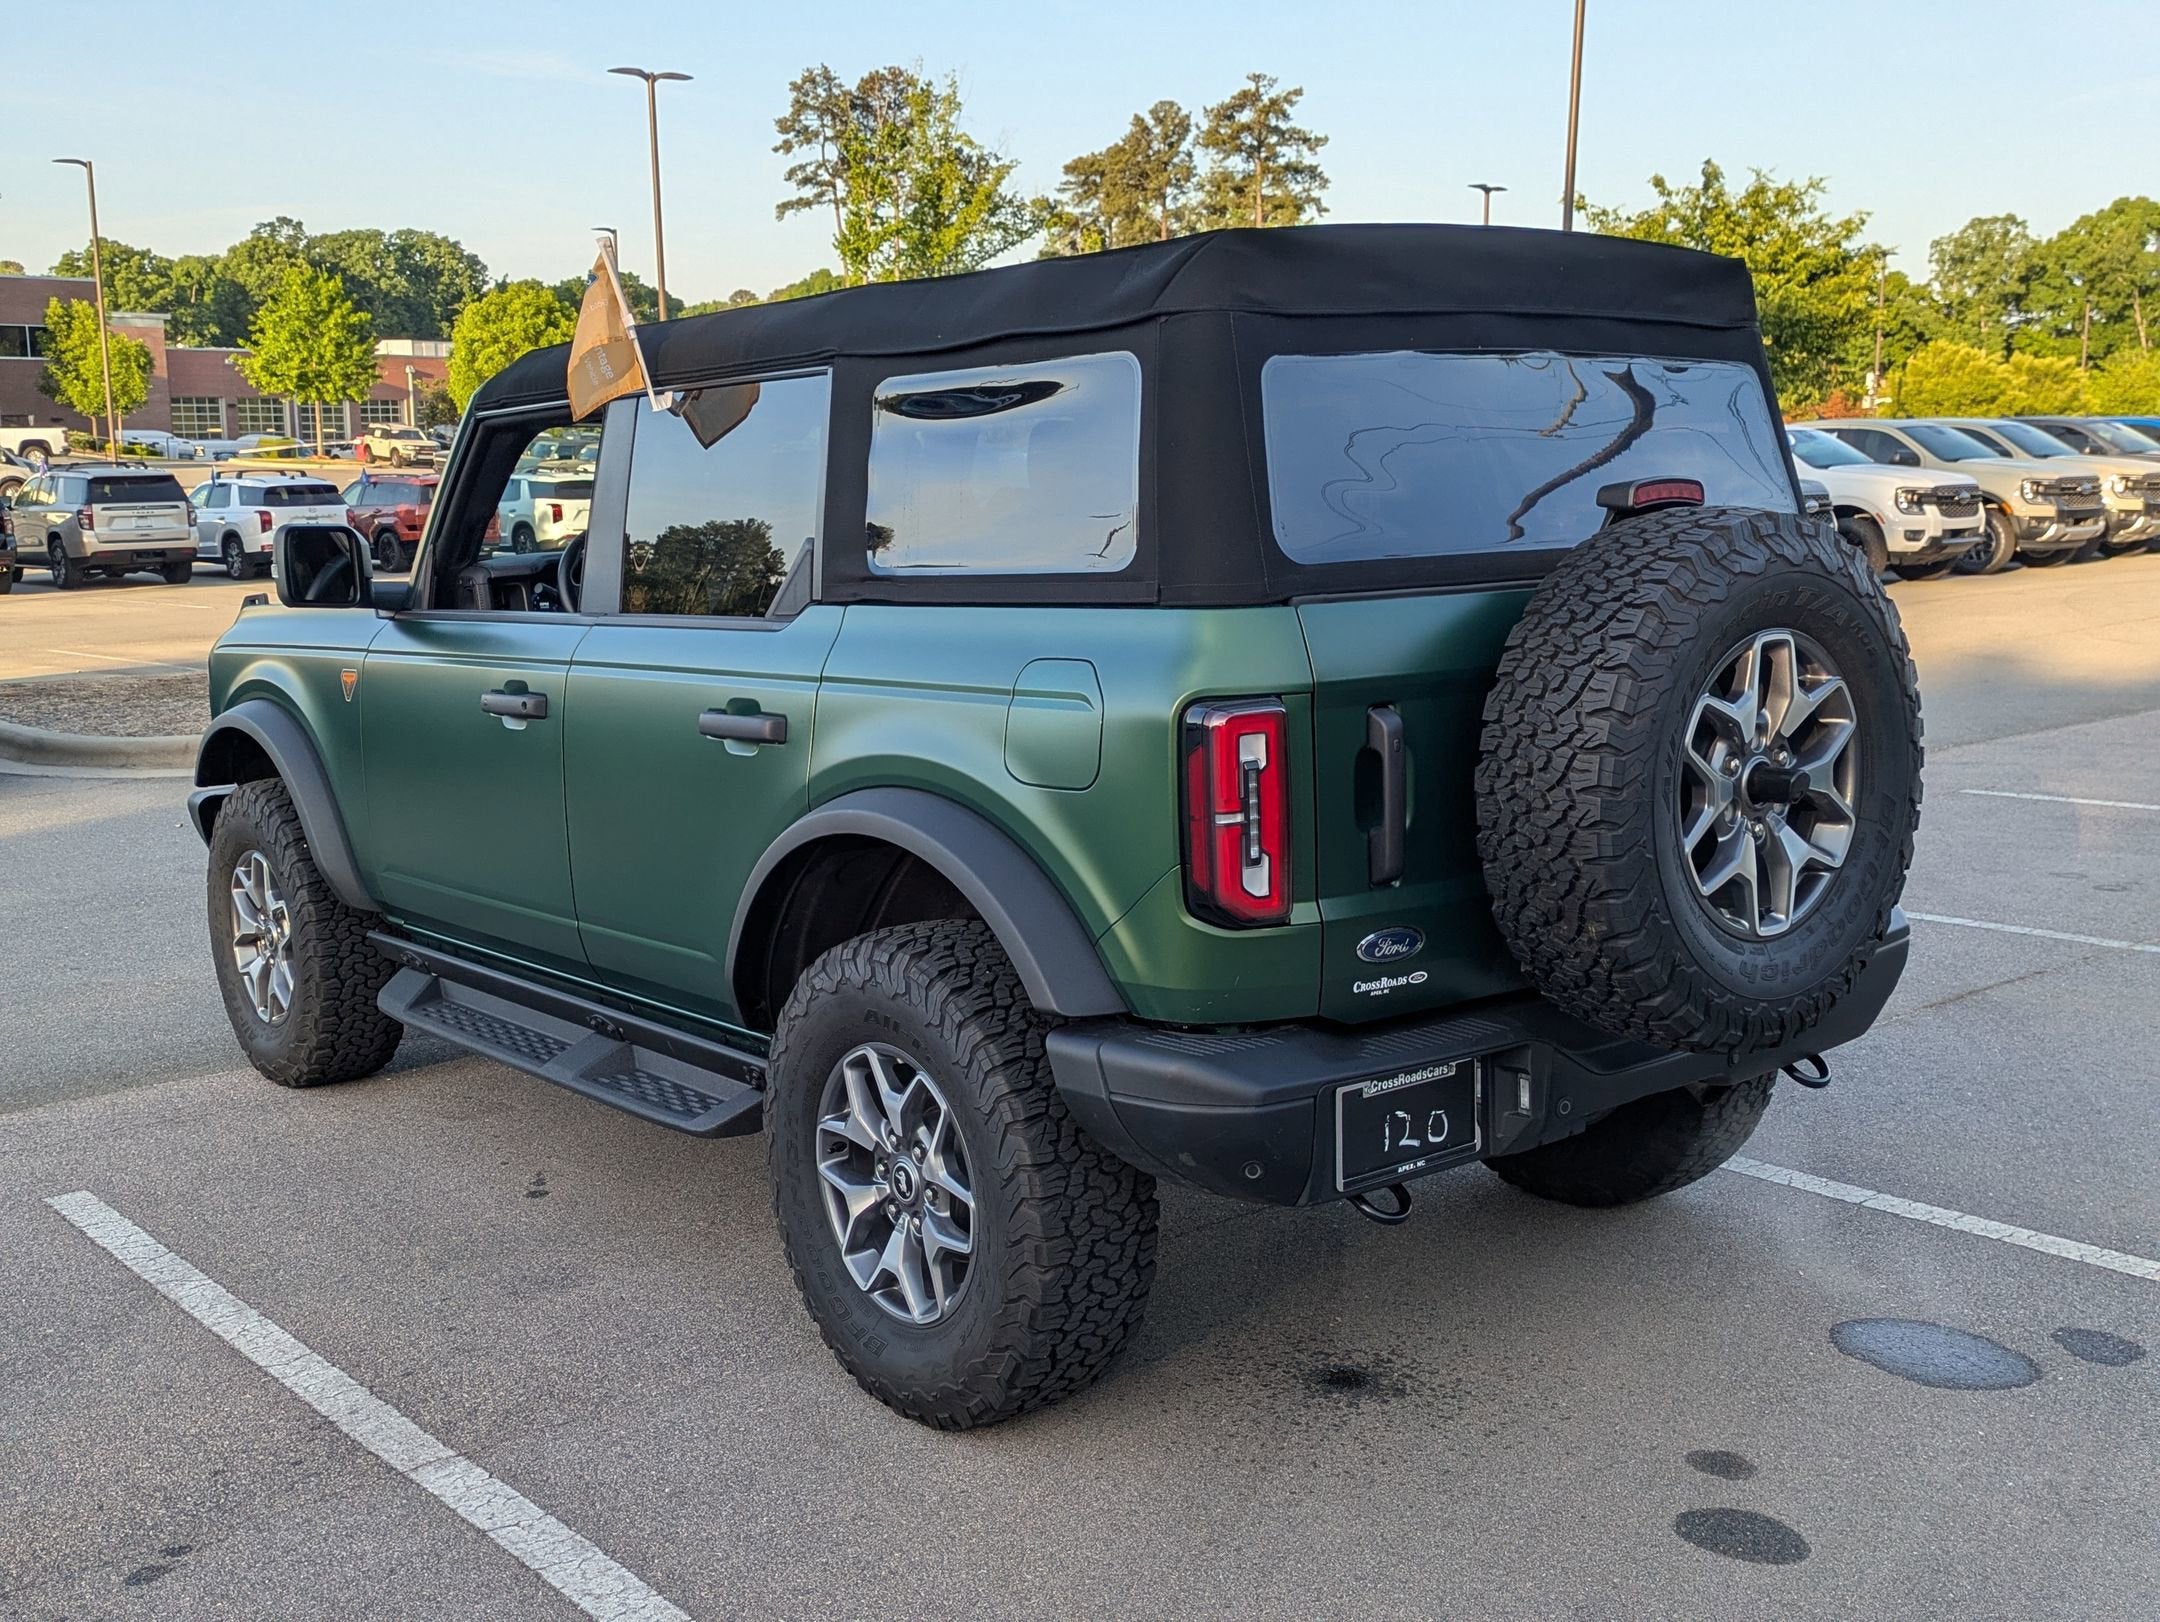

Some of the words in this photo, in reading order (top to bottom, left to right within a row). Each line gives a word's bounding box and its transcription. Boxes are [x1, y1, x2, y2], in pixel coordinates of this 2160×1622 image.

[1375, 938, 1409, 957] Ford
[1370, 1065, 1448, 1094] CrossRoadsCars
[1416, 1159, 1426, 1168] NC
